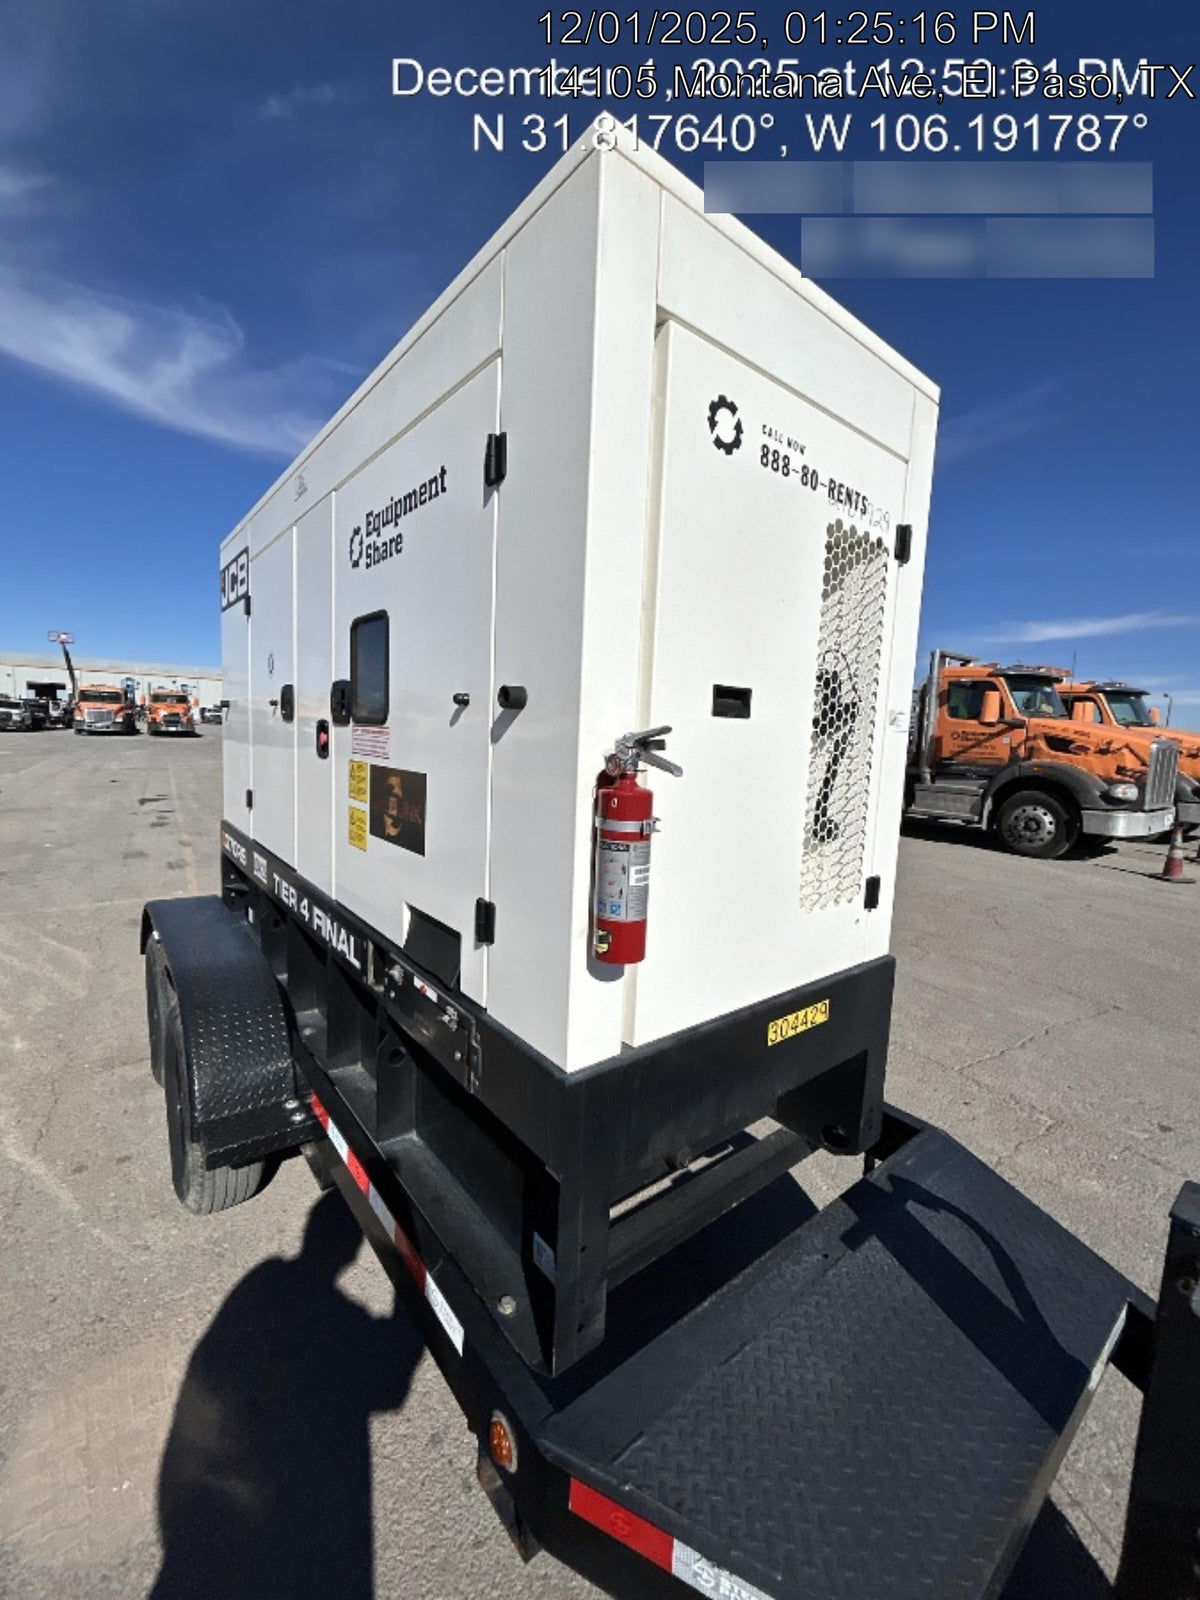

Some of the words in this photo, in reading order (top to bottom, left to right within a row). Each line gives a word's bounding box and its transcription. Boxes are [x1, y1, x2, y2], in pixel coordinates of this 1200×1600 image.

[365, 465, 447, 538] Equipment
[760, 443, 869, 516] 888-80-RENTS
[220, 550, 248, 611] JCB
[365, 532, 403, 570] Share
[272, 872, 298, 913] TIER
[300, 897, 310, 922] 4
[313, 903, 361, 970] FINAL
[768, 1001, 828, 1043] 304429
